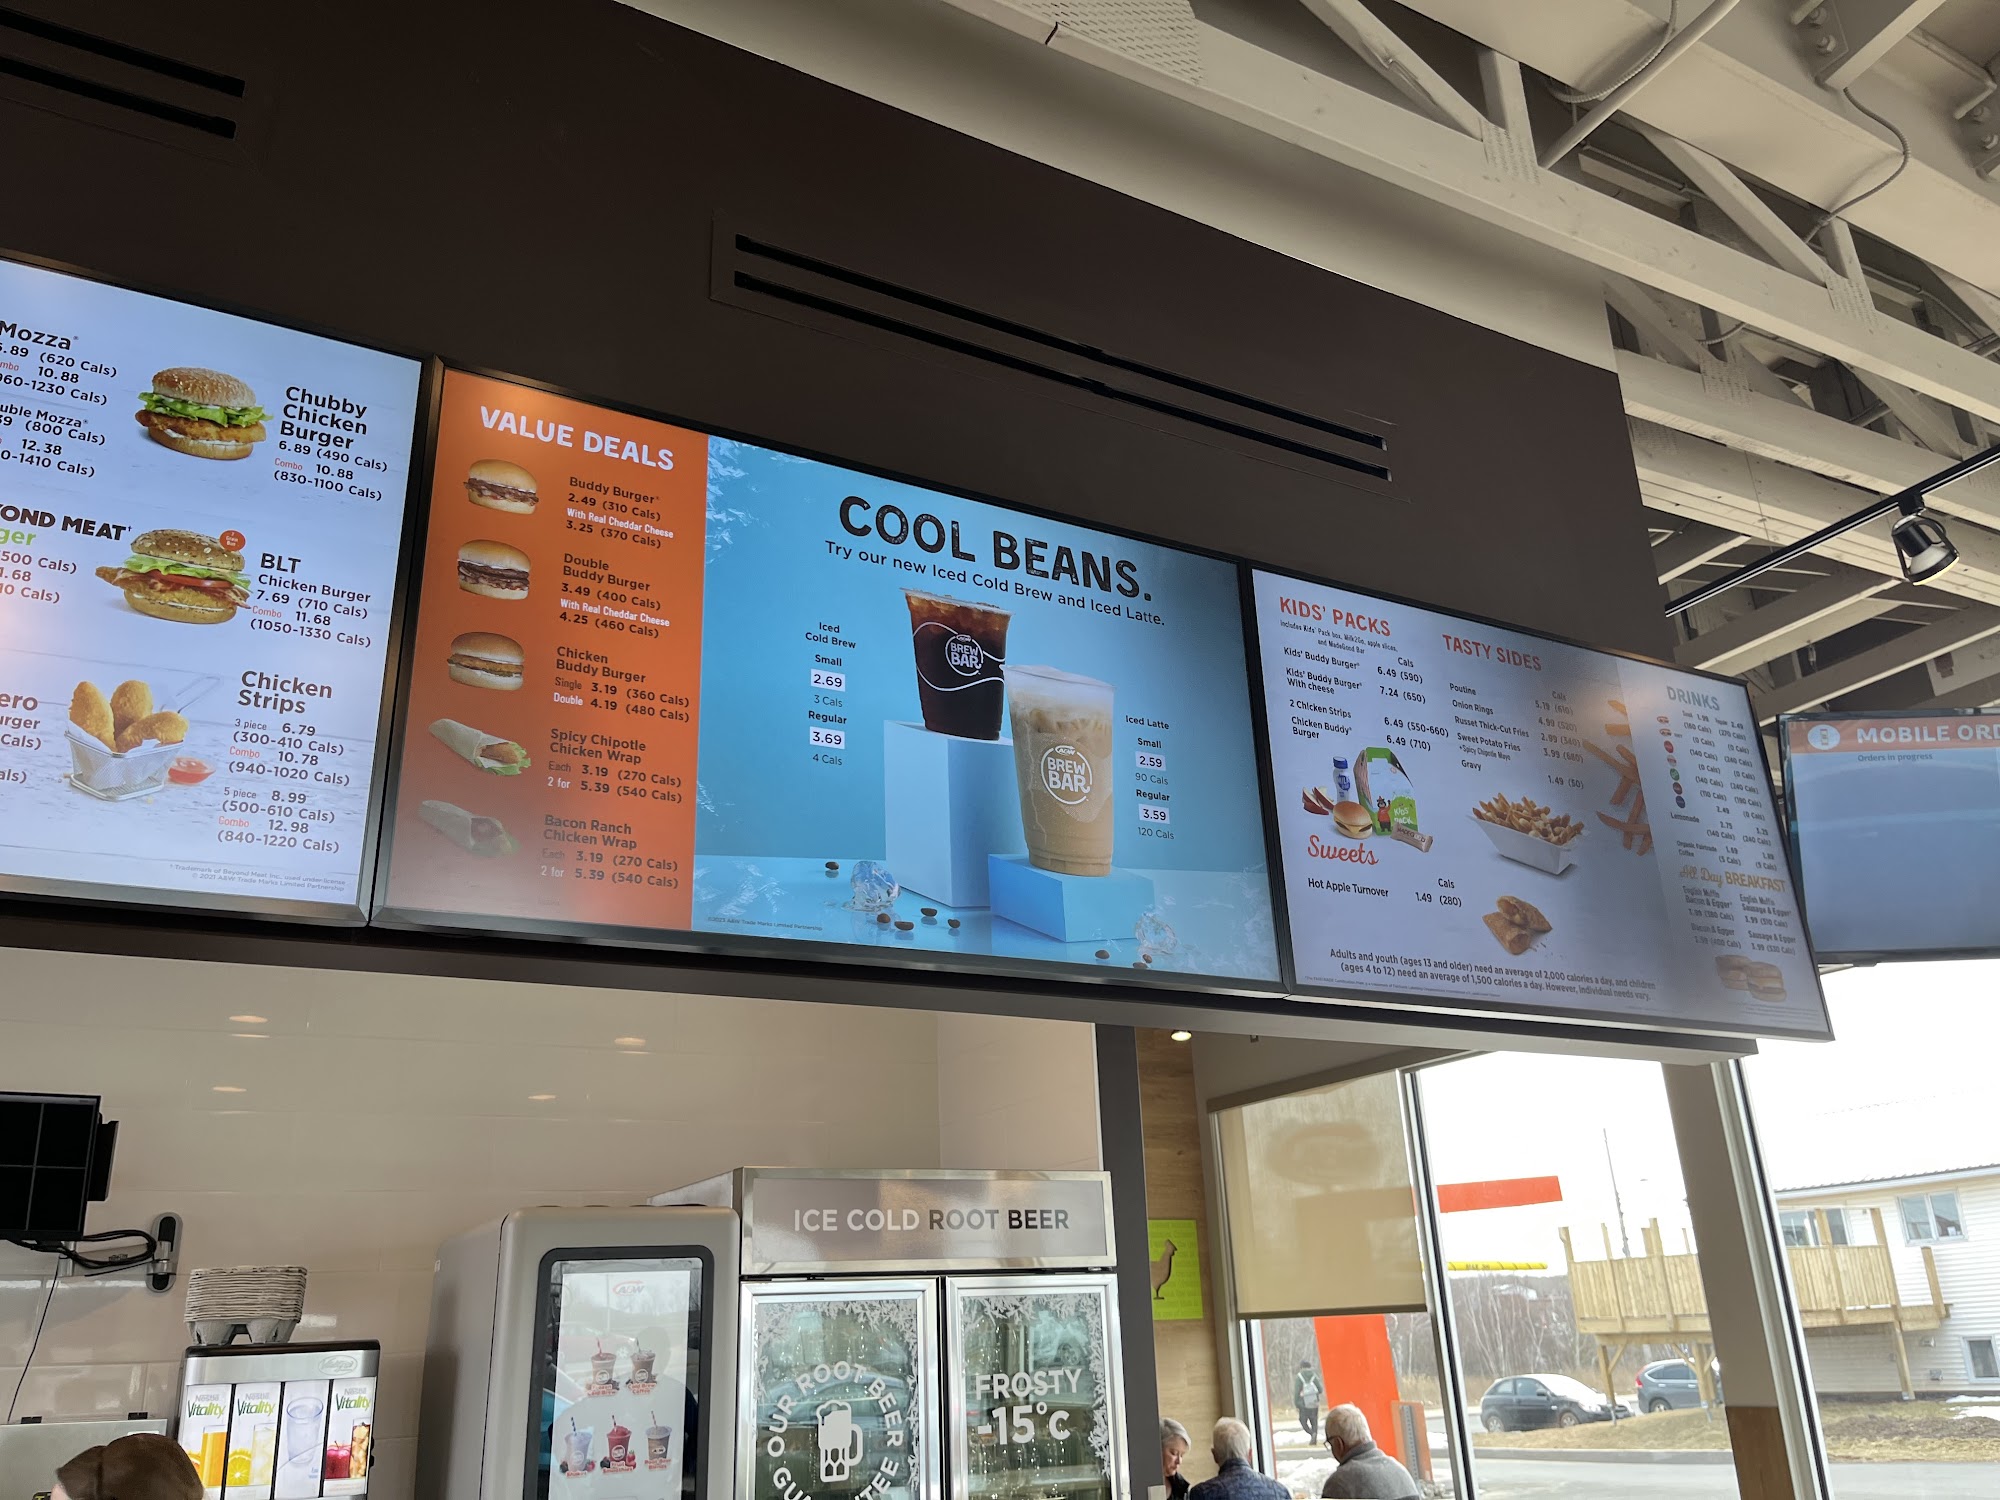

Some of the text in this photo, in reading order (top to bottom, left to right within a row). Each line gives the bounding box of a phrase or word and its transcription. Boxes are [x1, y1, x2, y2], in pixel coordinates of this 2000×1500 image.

[285, 386, 367, 419] Chubby
[282, 404, 367, 435] Chicken
[279, 421, 355, 451] Burger
[480, 406, 674, 470] VALUE DEALS
[278, 441, 388, 472] 6.89 (490 Cals)
[274, 458, 354, 481] Combo 10.88
[273, 470, 382, 501] (830-1100 Cals)
[568, 492, 661, 522] 2.49 (310 Cals)
[566, 508, 674, 538] With Real Cheddar Cheese
[566, 520, 662, 549] 3.25 (370 Cals)
[839, 495, 1153, 601] COOL BEANS.
[260, 553, 301, 574] BLT
[564, 554, 609, 571] Double
[257, 574, 371, 603] Chicken Burger
[562, 565, 650, 592] Buddy Burger
[825, 541, 1165, 627] Try our new Iced Cold Brew and Iced Latte.
[256, 590, 369, 619] 7.69 (710 Cals)
[561, 582, 662, 612] 3.49 (400 Cals)
[252, 606, 332, 626] Combo 11.68
[560, 598, 670, 627] With Real Cheddar Cheese
[1280, 597, 1391, 636] KIDS' PACKS
[250, 619, 372, 648] (1050-1330 Cals)
[560, 612, 659, 638] 4.25 (460 Cals)
[819, 622, 841, 634] Iced
[805, 633, 856, 649] Cold Brew
[951, 642, 979, 656] BREW
[557, 646, 608, 664] Chicken
[814, 655, 843, 667] Small
[951, 654, 982, 670] BAR
[1442, 634, 1542, 672] TASTY SIDES
[556, 659, 646, 682] Buddy Burger
[813, 674, 843, 688] 2.69
[1378, 667, 1423, 684] 6.49 (590)
[241, 671, 333, 699] Chicken
[555, 677, 690, 708] Single 3.19 (360 Cals)
[1288, 678, 1335, 695] With cheese
[1380, 687, 1426, 704] 7.24 (650)
[1450, 683, 1476, 696] Poutine
[237, 690, 306, 715] Strips
[554, 692, 690, 723] Double 4.19 (480 Cals)
[814, 695, 843, 707] 3 Cals
[1296, 701, 1328, 714] Chicken
[1329, 706, 1351, 718] Strips
[1452, 700, 1494, 715] Onion Rings
[1666, 686, 1720, 711] DRINKS
[234, 719, 316, 737] 3 piece 6.79
[808, 711, 847, 726] Regular
[1125, 715, 1170, 730] Iced Latte
[1454, 716, 1530, 738] Russet Thick-Cut Fries
[232, 731, 345, 756] (300-410 Cals)
[550, 728, 646, 752] Spicy Chipotle
[812, 731, 843, 746] 3.69
[1137, 737, 1162, 749] Small
[1857, 725, 1949, 744] MOBILE
[229, 747, 319, 766] Combo 10.78
[550, 742, 642, 766] Chicken Wrap
[812, 753, 843, 766] 4 Cals
[1139, 756, 1163, 768] 2.59
[1898, 753, 1933, 762] progress
[228, 760, 351, 784] (940-1020 Cals)
[1047, 758, 1086, 775] BREW
[1461, 760, 1482, 771] Gravy
[1048, 771, 1091, 794] BAR
[1135, 774, 1168, 786] 90 Cals
[1136, 790, 1171, 801] Regular
[1143, 809, 1167, 821] 3.59
[1138, 828, 1175, 840] 120 Cals
[1307, 834, 1379, 866] Sweets
[1308, 878, 1462, 908] Hot Apple Turnover 1.49 (280)
[794, 1209, 1069, 1232] ICE COLD ROOT BEER
[975, 1368, 1082, 1400] FROSTY
[187, 1400, 226, 1418] Vitality
[237, 1397, 275, 1417] Vitality
[335, 1394, 370, 1411] Vitality
[767, 1360, 902, 1458] OUR ROOT BEER
